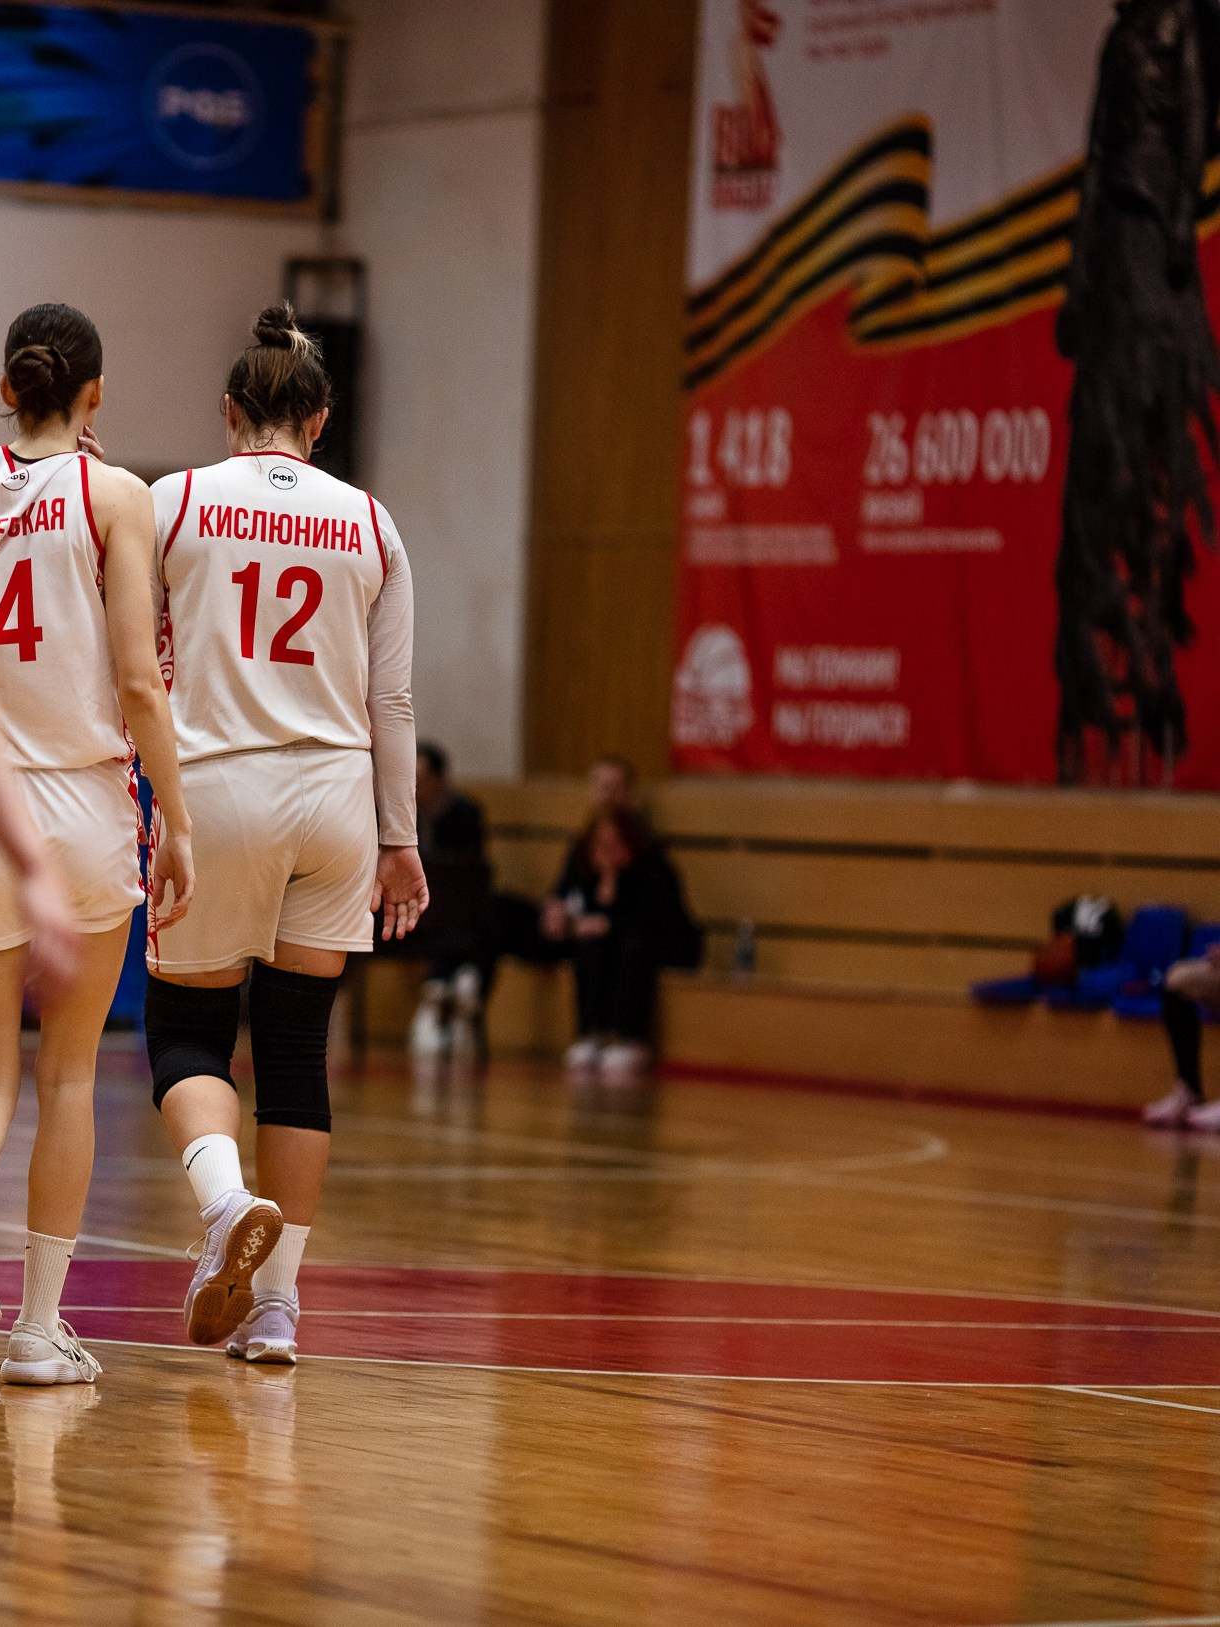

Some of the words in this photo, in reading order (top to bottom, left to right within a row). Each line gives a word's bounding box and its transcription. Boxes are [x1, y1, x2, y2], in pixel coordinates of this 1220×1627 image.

[272, 473, 294, 483] РФБ
[198, 505, 363, 555] КИСЛЮНИНА
[231, 561, 324, 666] 12
